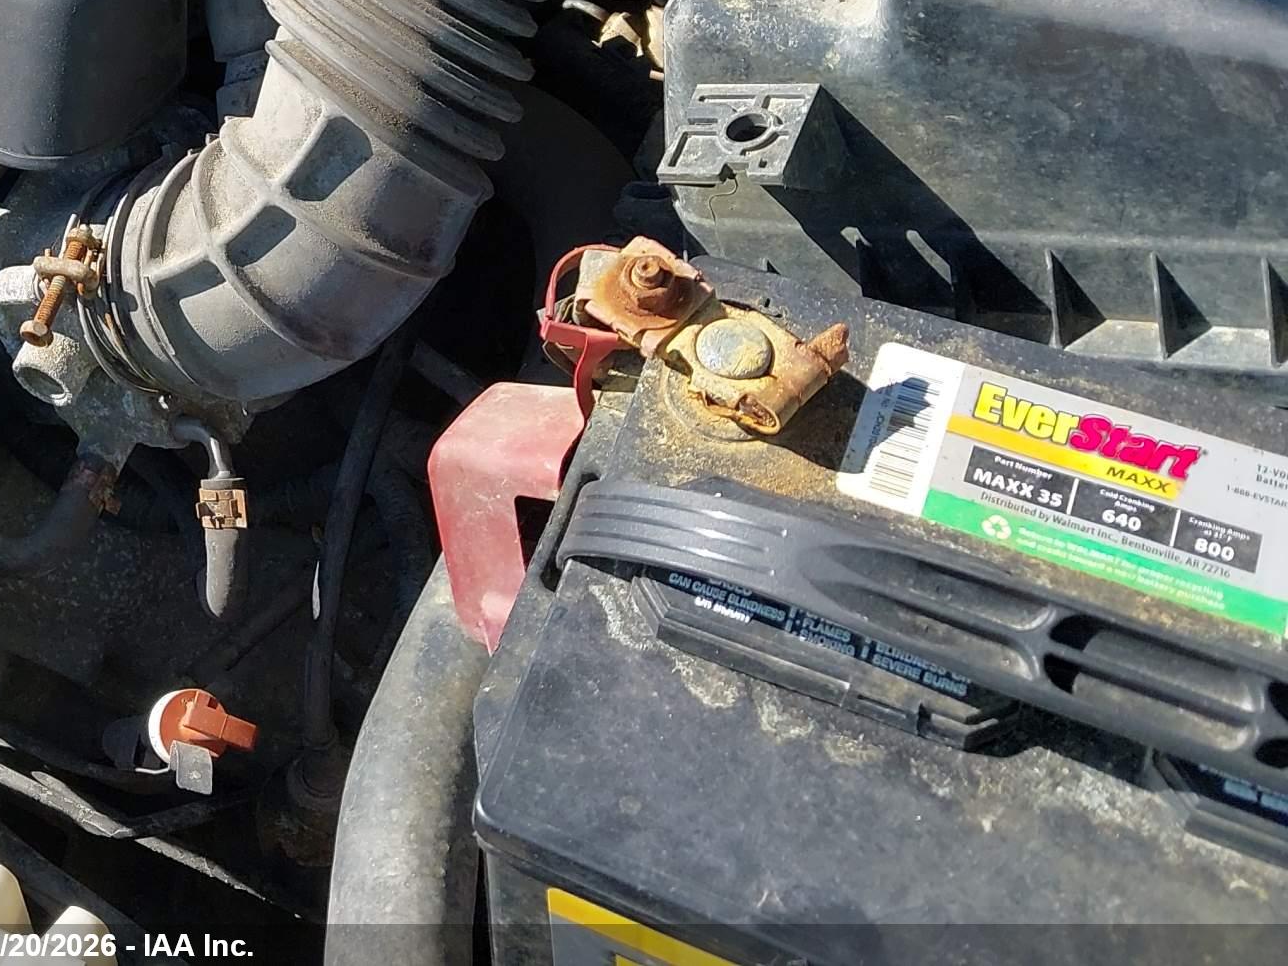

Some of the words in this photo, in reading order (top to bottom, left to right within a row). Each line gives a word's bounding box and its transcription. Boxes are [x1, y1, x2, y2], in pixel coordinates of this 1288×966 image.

[972, 381, 1202, 479] EverStart
[994, 455, 1015, 468] Part
[973, 468, 1033, 500] MAXX
[1038, 488, 1063, 508] 35
[1106, 466, 1169, 495] MAXX
[981, 491, 1037, 518] Distributed
[1038, 510, 1051, 523] by
[1052, 513, 1096, 534] Walmart
[1102, 509, 1142, 532] 640
[1194, 537, 1235, 562] 800
[669, 572, 691, 588] CAN
[692, 580, 726, 602] CAUSE
[728, 591, 786, 622] BLINDNESS
[803, 617, 851, 643] FLAMES
[873, 652, 922, 680] SEVERE
[923, 671, 968, 698] BURNS
